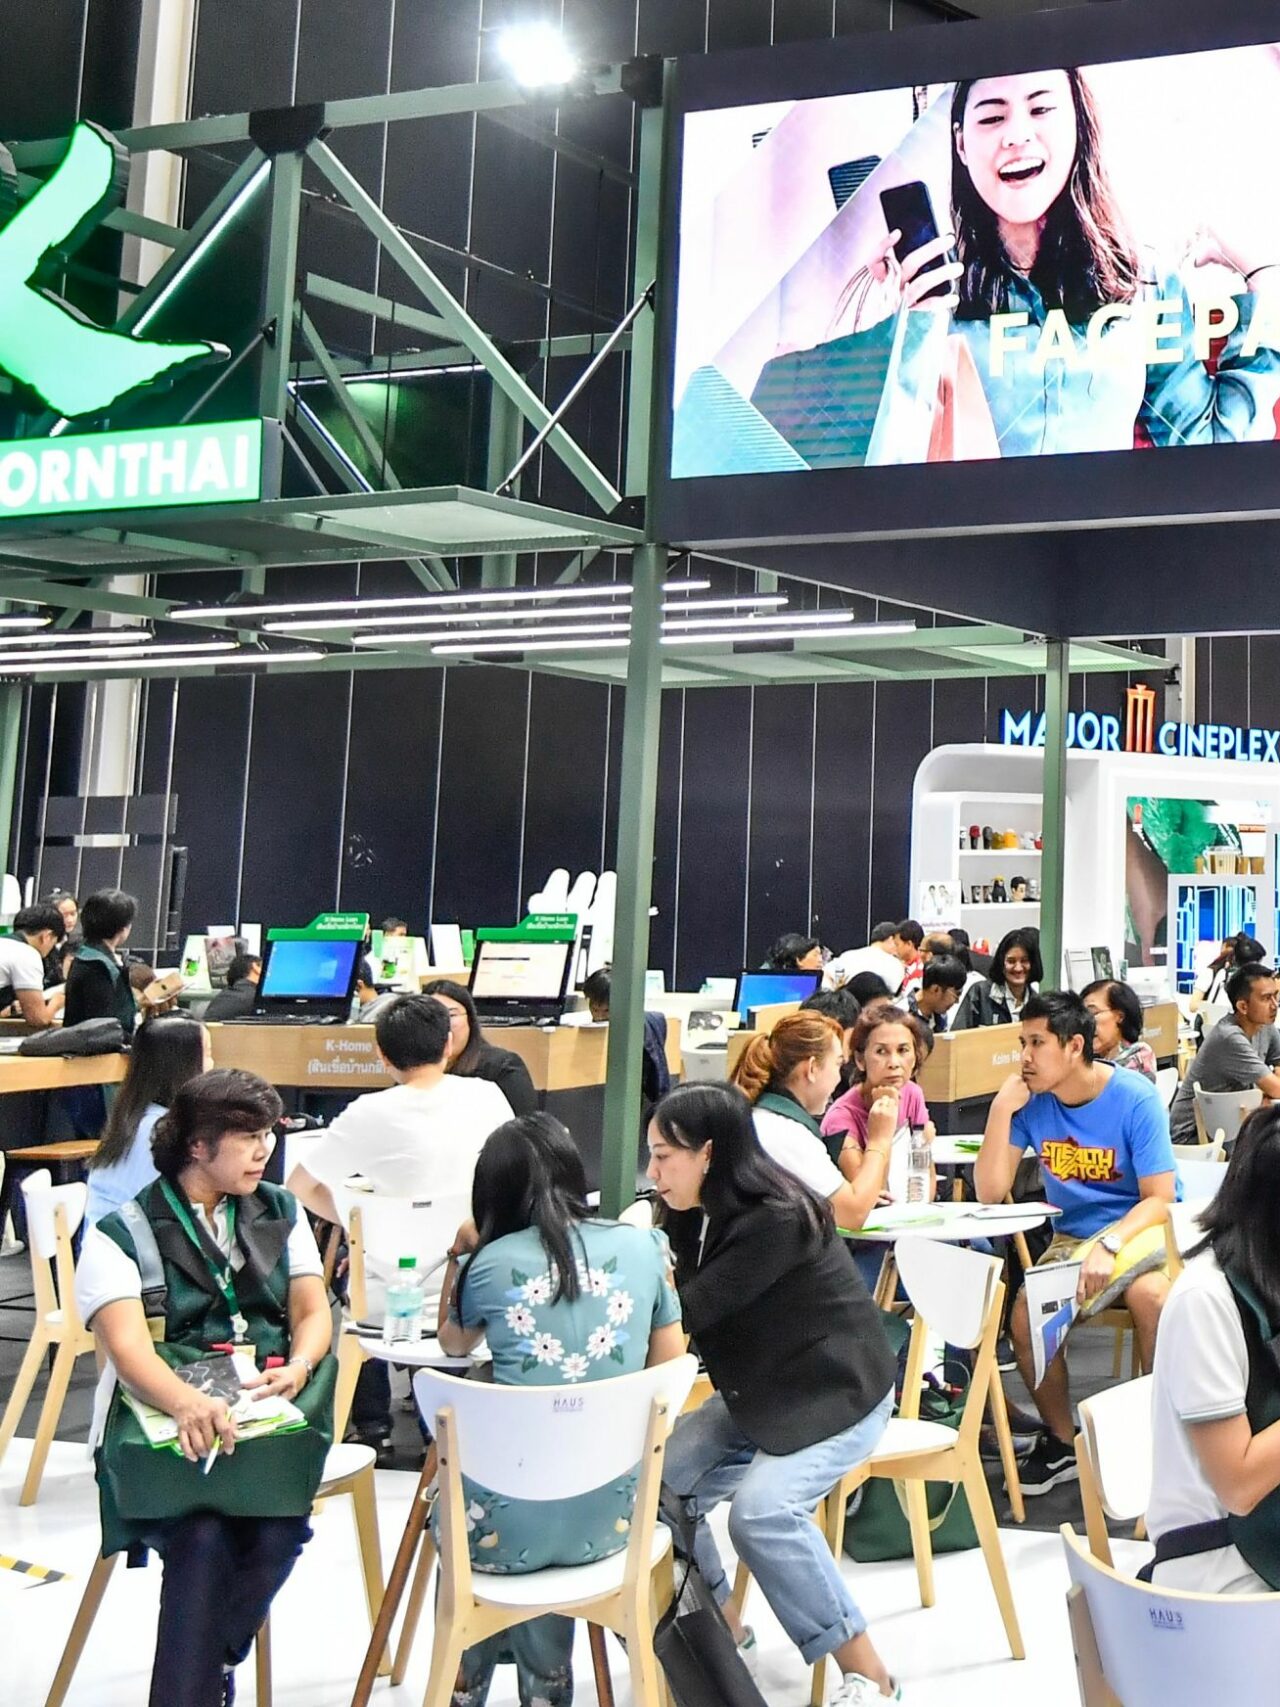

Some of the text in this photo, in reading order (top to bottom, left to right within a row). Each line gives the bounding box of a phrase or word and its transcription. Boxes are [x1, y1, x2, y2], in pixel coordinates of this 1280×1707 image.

[325, 1039, 373, 1052] K-Home
[1041, 1141, 1114, 1168] STEALTH
[1051, 1159, 1111, 1181] WATCH
